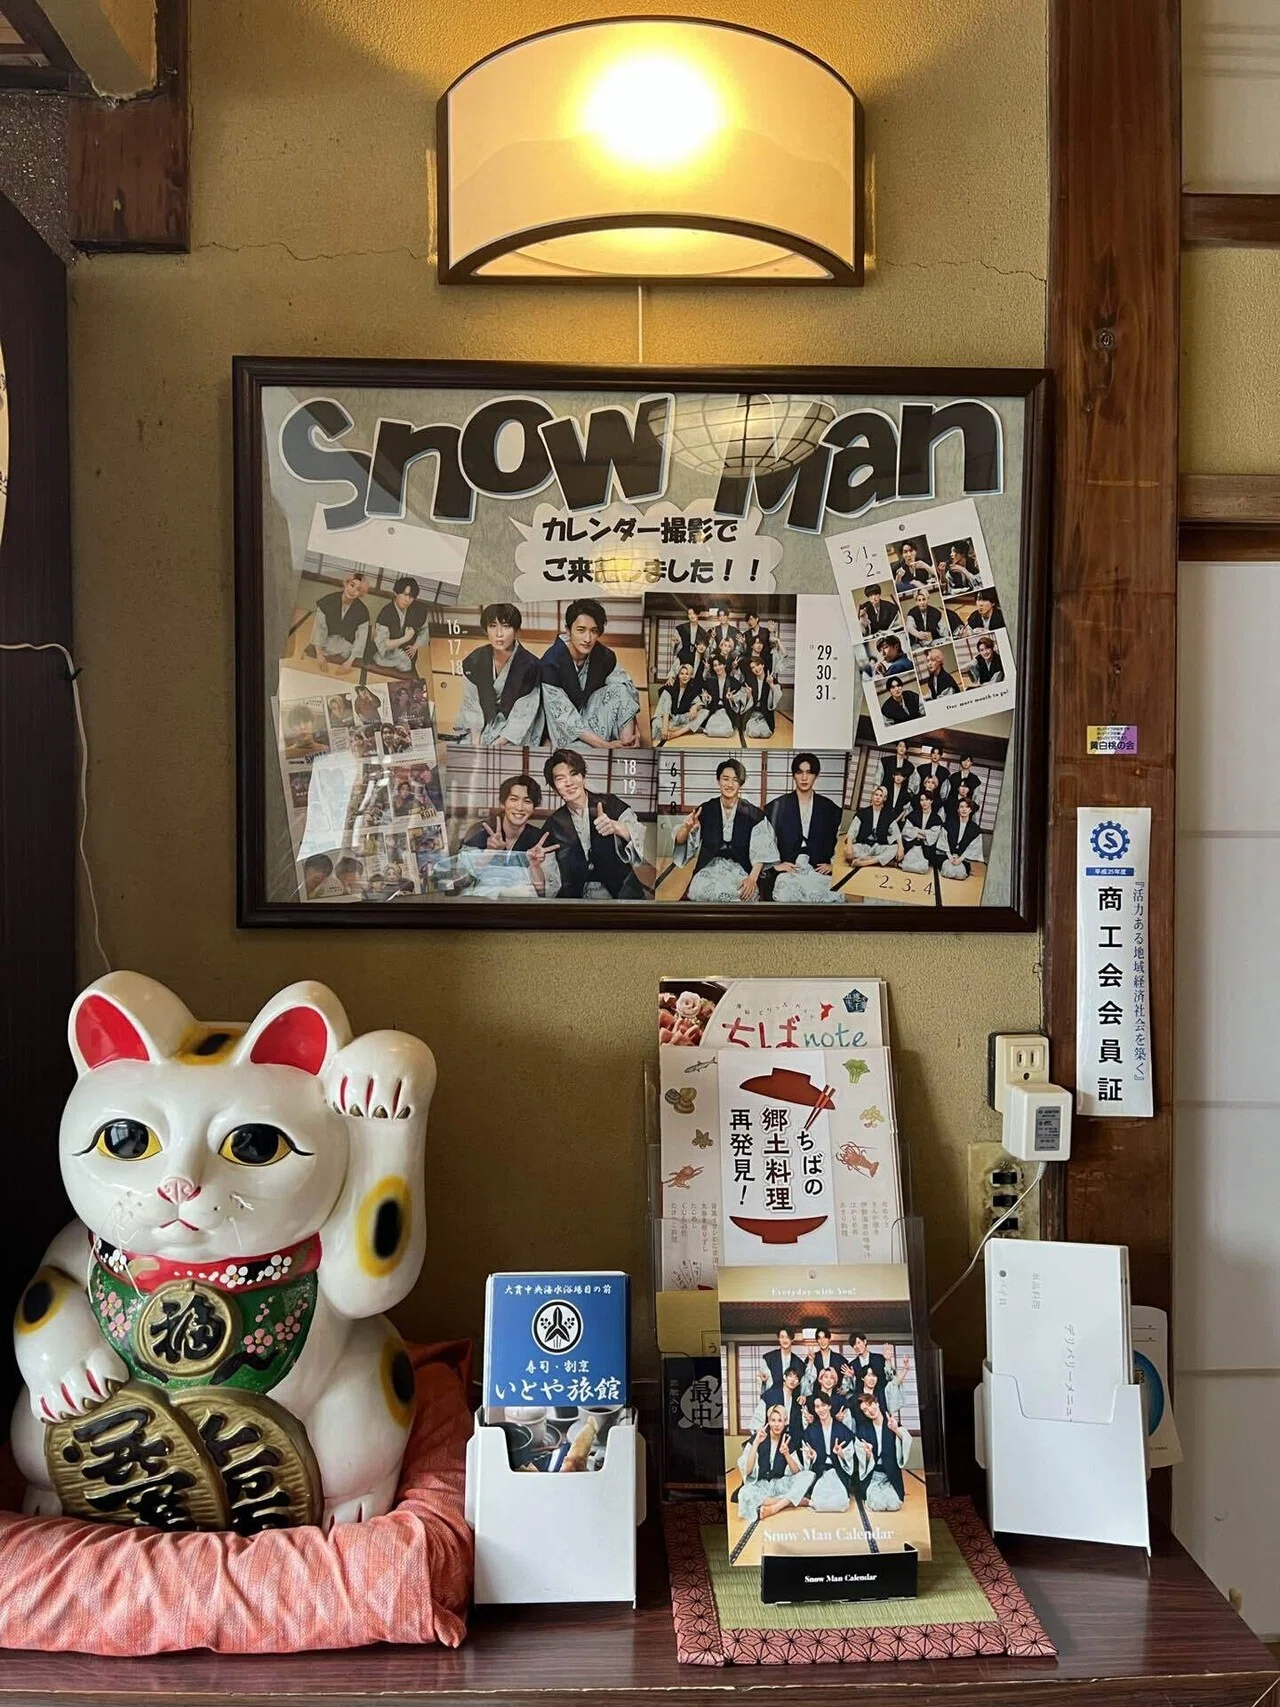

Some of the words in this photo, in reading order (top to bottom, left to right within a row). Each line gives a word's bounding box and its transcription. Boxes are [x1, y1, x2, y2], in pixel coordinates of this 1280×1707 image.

[279, 394, 675, 533] Snow
[713, 394, 1004, 534] Man
[542, 516, 739, 545] カレンダー撮影で
[865, 562, 875, 578] 2
[446, 619, 461, 635] 16
[448, 639, 461, 655] 17
[817, 644, 832, 660] 29
[816, 664, 832, 680] 30
[816, 684, 829, 700] 31
[623, 759, 637, 775] 18
[670, 762, 677, 777] 6
[623, 779, 636, 795] 19
[670, 781, 677, 796] 7
[879, 874, 889, 889] 2
[902, 878, 912, 892] 3
[923, 882, 933, 895] 4
[1132, 881, 1147, 1082] 『活力ある地域経済社会を築く』
[1097, 886, 1124, 1102] 商工会会員証
[728, 1109, 756, 1206] 再発見！
[761, 1107, 794, 1212] 郷土料理
[796, 1130, 824, 1196] ちばの
[504, 1284, 612, 1296] 大貫中央海水浴場目の前
[525, 1359, 590, 1374] 寿司・割烹
[1064, 1323, 1077, 1423] デリバリーメニュ
[495, 1376, 622, 1402] いとや旅館
[689, 1380, 713, 1427] 最中
[763, 1529, 799, 1542] Snow
[803, 1527, 833, 1541] Man
[835, 1526, 895, 1541] Calendar
[804, 1575, 825, 1583] Snow
[826, 1574, 843, 1582] Man
[844, 1573, 878, 1582] Calendar
